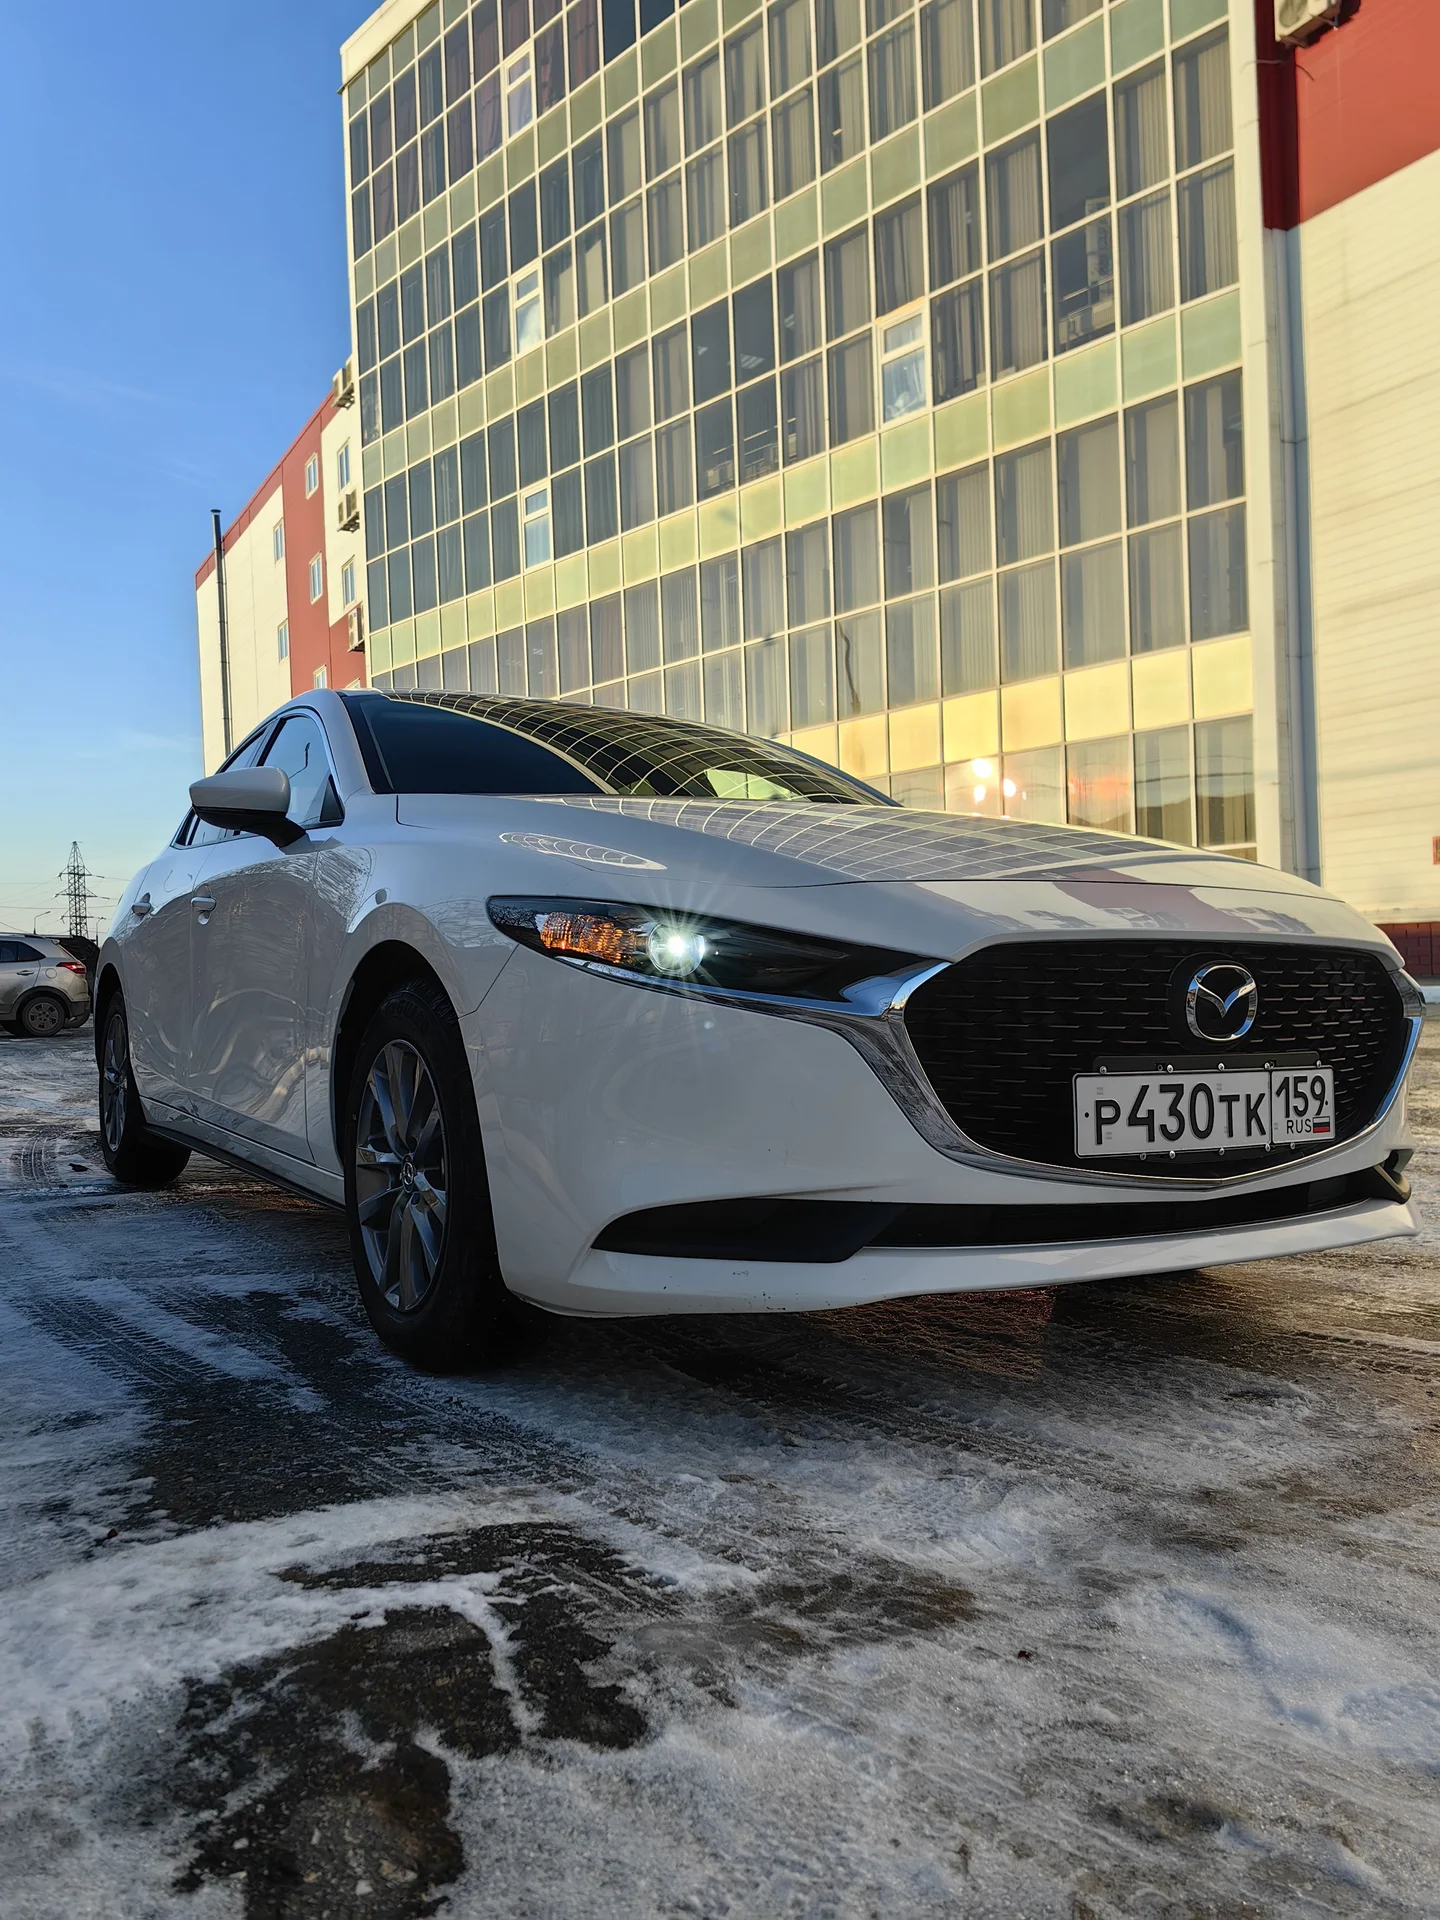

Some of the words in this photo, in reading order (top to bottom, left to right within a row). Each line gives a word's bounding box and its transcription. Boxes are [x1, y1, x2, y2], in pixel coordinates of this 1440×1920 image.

[1095, 1082, 1267, 1146] Р430ТК
[1275, 1075, 1326, 1118] 159
[1286, 1118, 1312, 1134] RUS
